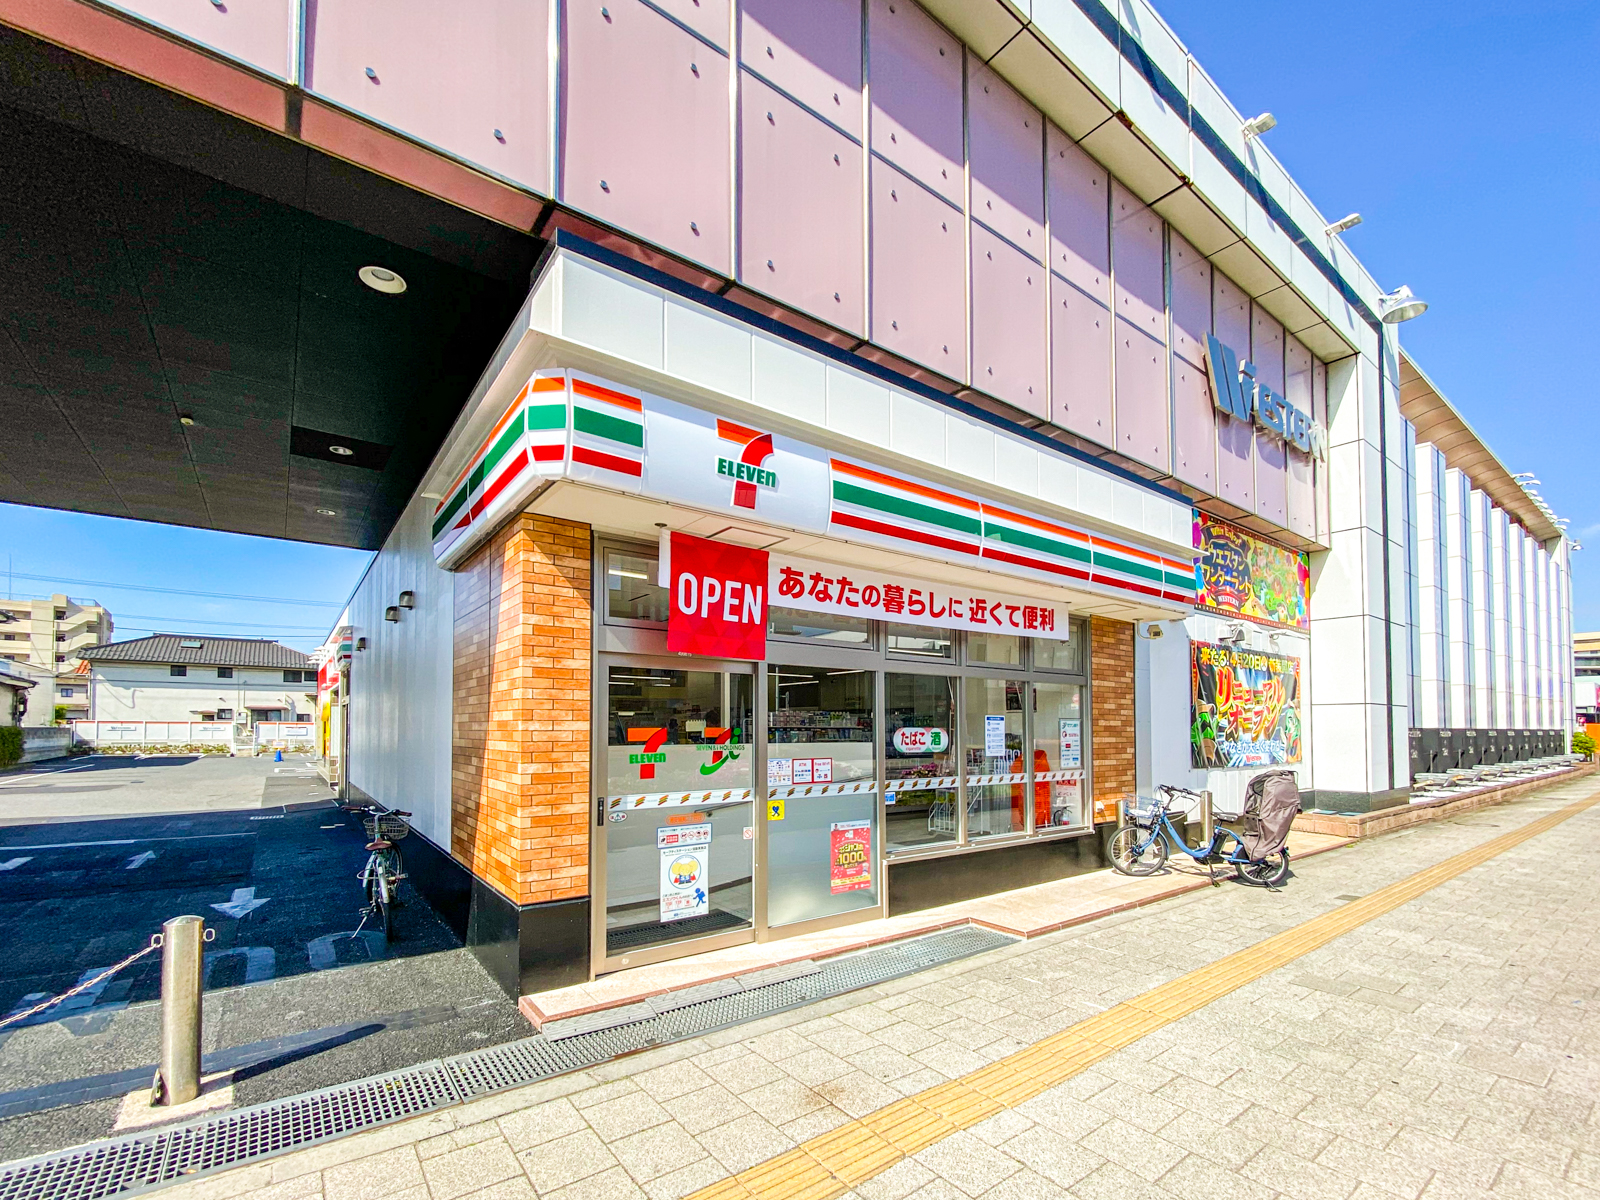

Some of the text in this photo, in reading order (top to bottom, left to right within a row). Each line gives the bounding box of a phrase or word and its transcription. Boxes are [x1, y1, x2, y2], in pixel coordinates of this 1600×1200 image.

[677, 571, 763, 625] OPEN
[1226, 704, 1279, 735] オープン
[901, 731, 941, 746] たばこ 酒
